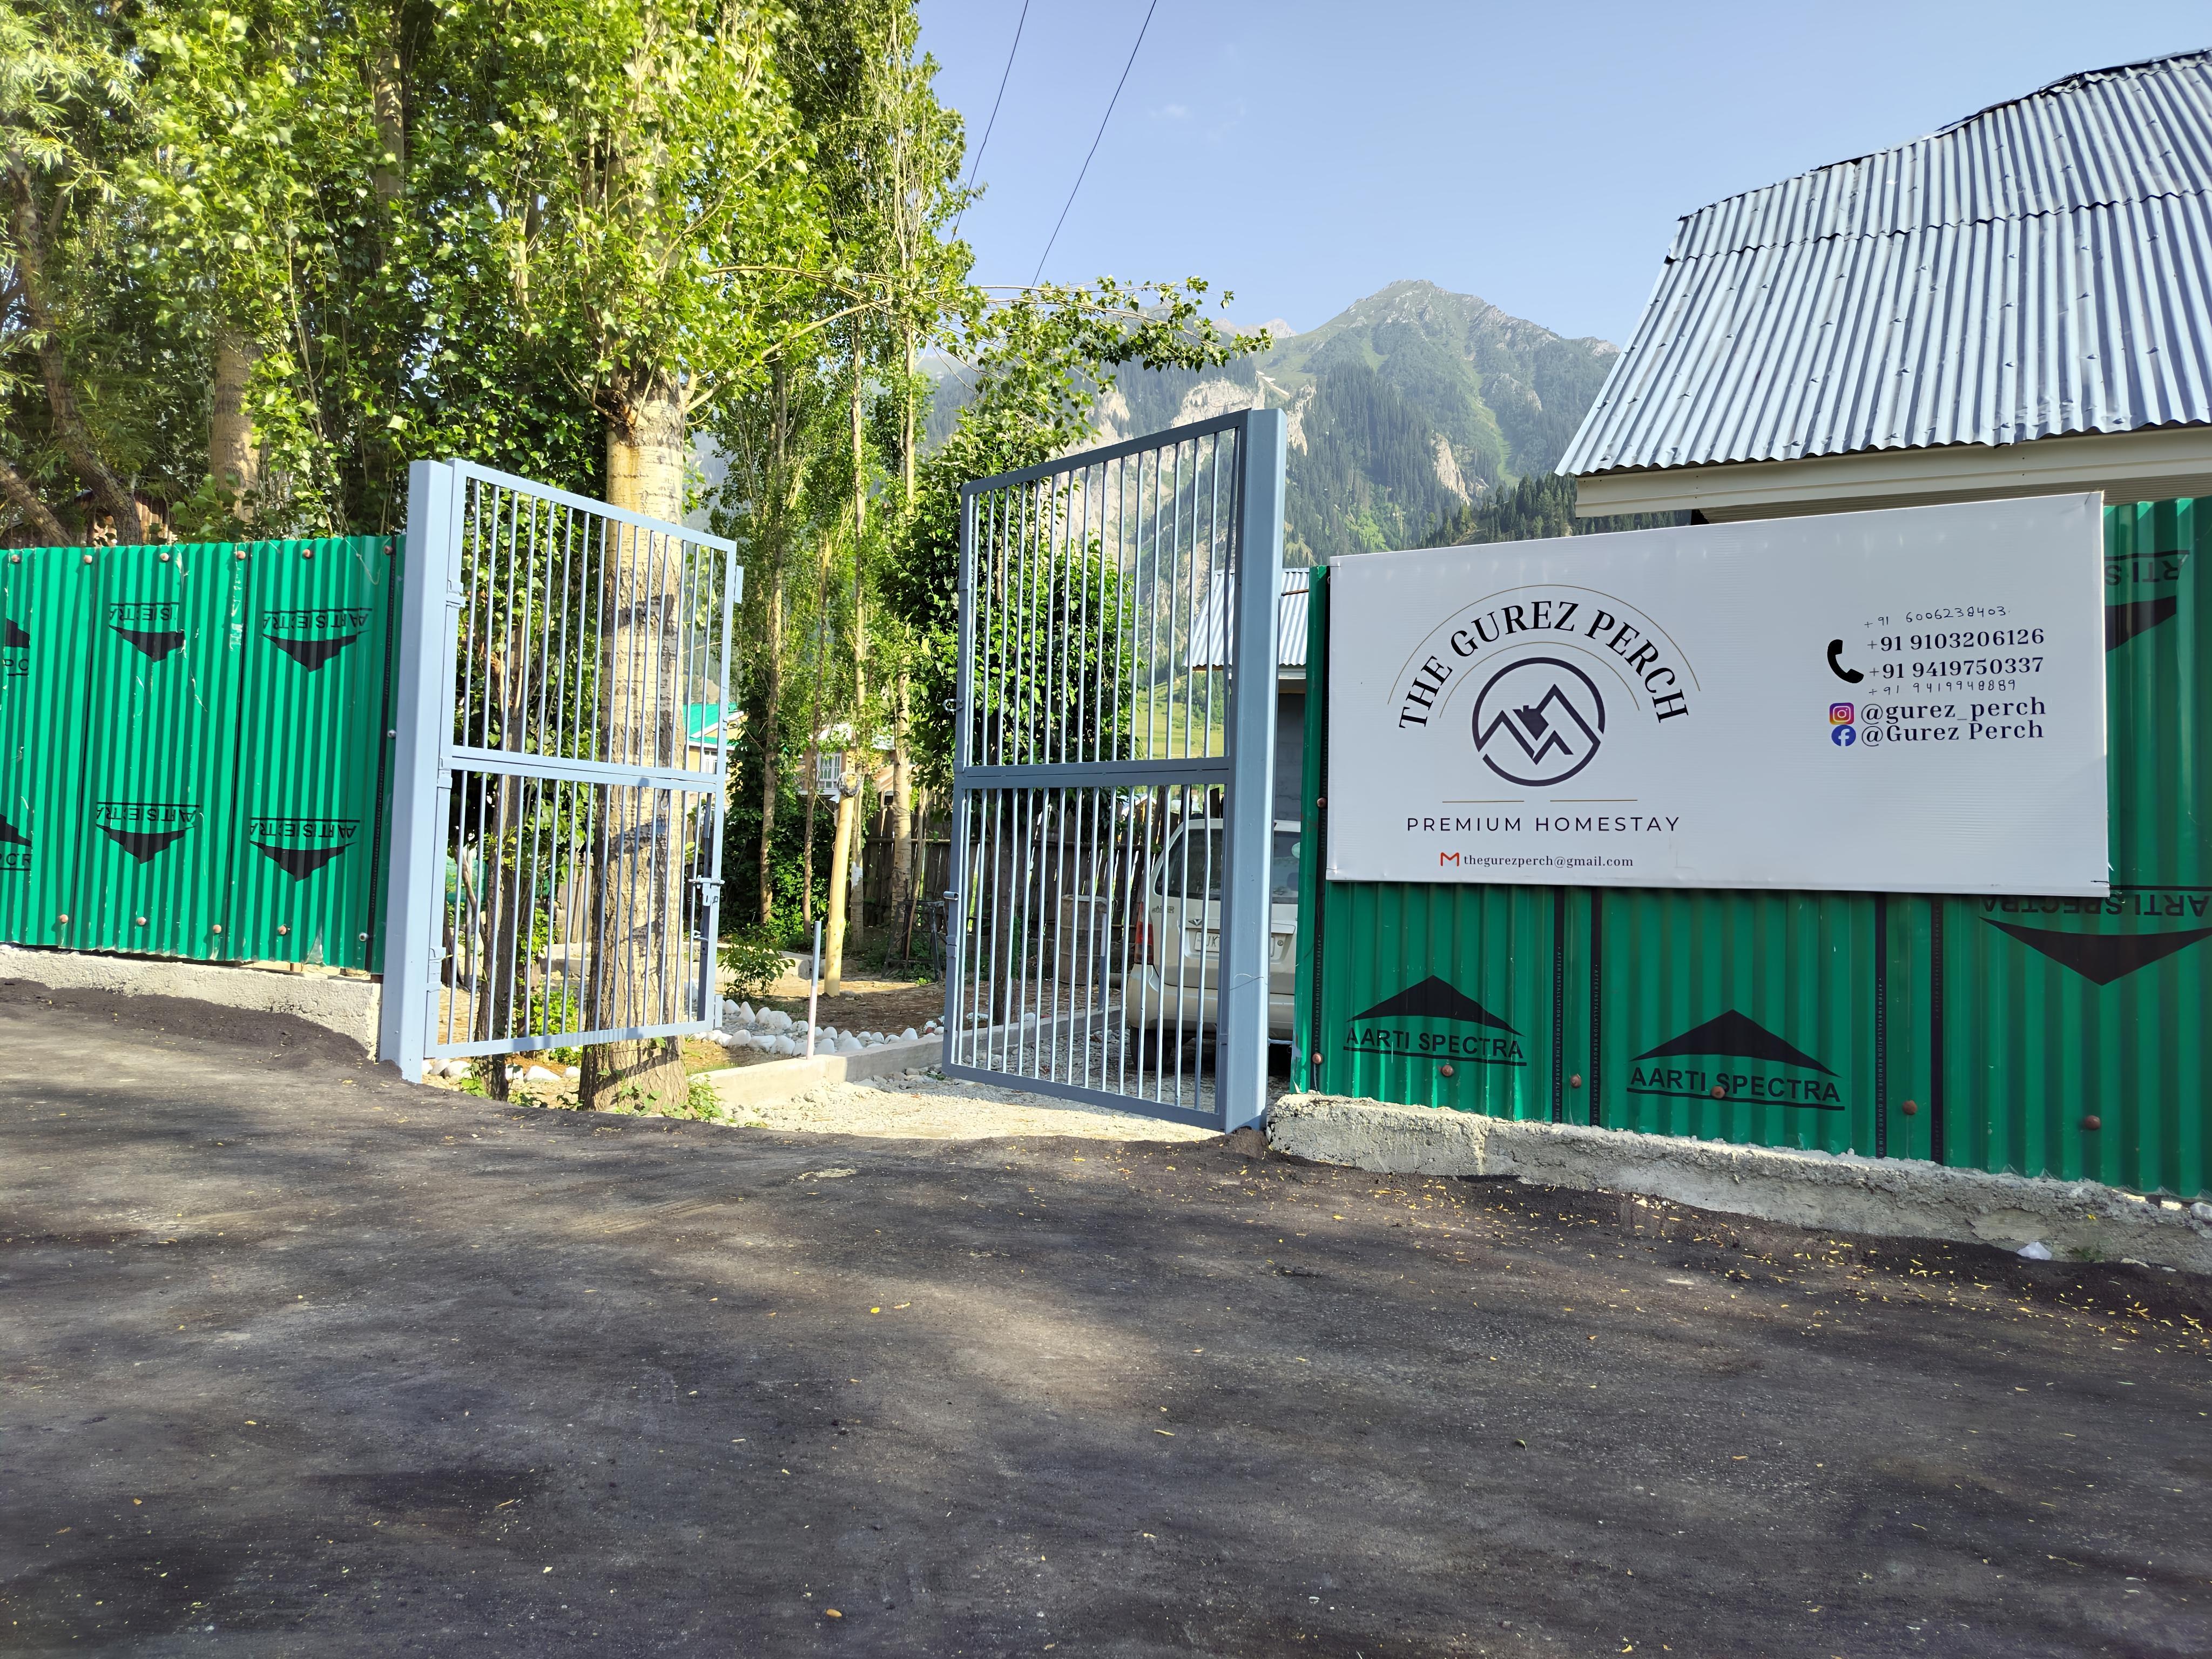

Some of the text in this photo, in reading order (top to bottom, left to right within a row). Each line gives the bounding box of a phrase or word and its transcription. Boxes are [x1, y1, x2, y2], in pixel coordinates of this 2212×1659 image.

[1906, 606, 2006, 623] 6006238403
[1867, 629, 2045, 651] +91 9103206126
[1399, 655, 1453, 729] THE
[1451, 601, 1579, 657] GUREZ
[1584, 609, 1689, 724] PERCH
[1869, 657, 2044, 679] +91 9419750337
[1913, 679, 2015, 693] 9419948889
[1861, 697, 2046, 725] @gurez_perch
[1862, 720, 2045, 747] @Gurez Perch
[1407, 817, 1679, 832] PREMIUM HOMESTAY
[1464, 855, 1634, 868] thegurezperch@gmail.com
[1346, 1028, 1523, 1058] AARTI SPECTRA
[1630, 1067, 1840, 1103] AARTI SPECTRA
